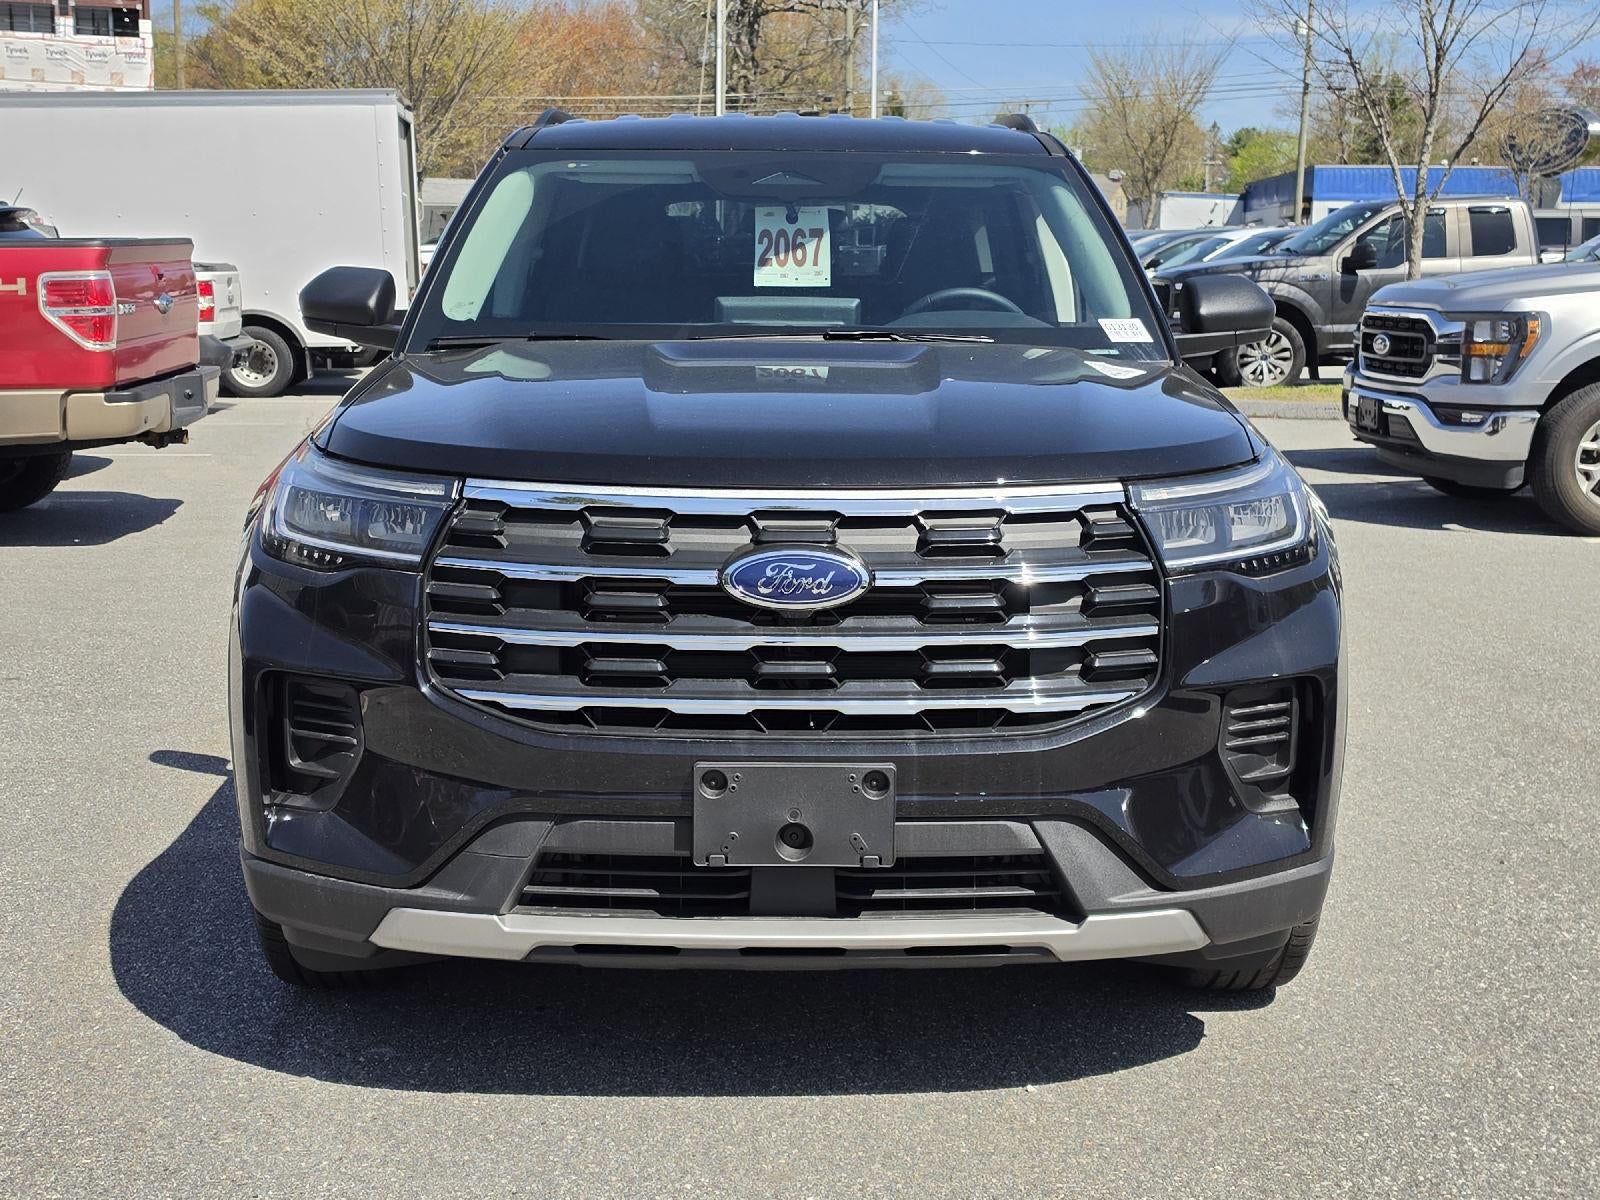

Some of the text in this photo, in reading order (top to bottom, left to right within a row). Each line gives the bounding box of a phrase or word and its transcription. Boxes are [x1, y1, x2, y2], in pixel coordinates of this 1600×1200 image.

[5, 46, 28, 54] Tyvek
[45, 48, 68, 56] Tyvek
[85, 50, 108, 58] Tyvek
[757, 228, 824, 268] 2067
[757, 562, 835, 594] Ford
